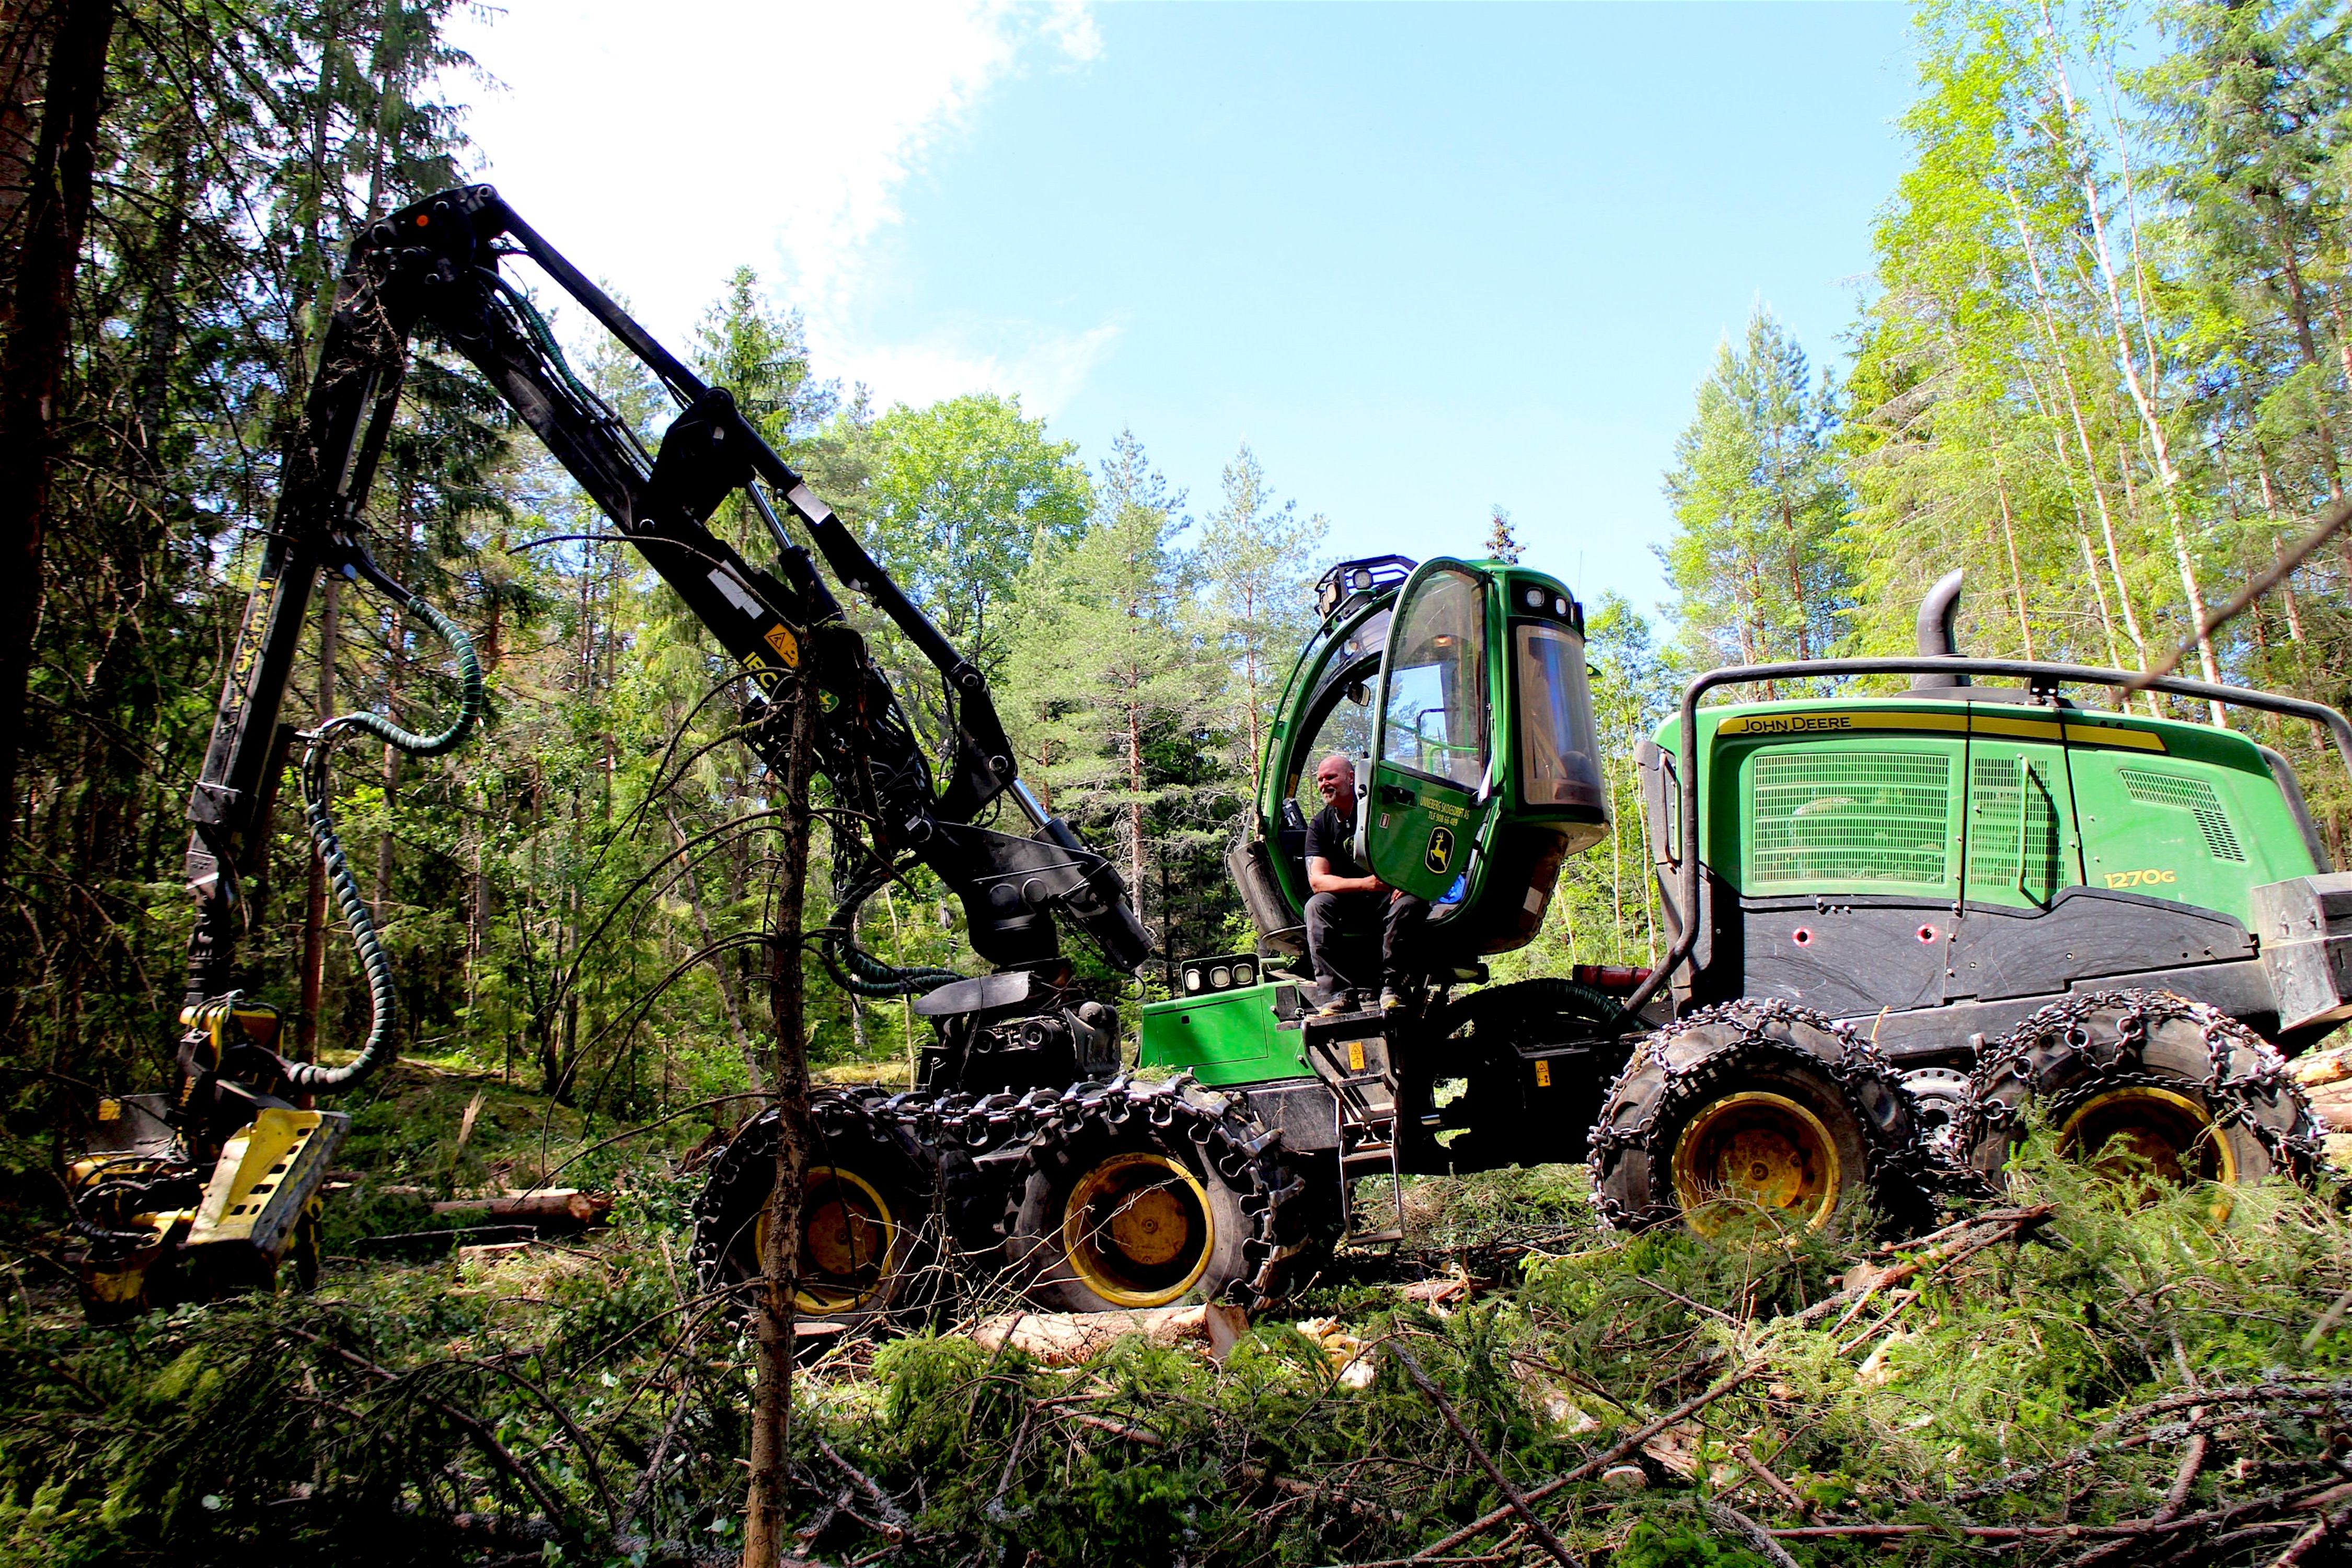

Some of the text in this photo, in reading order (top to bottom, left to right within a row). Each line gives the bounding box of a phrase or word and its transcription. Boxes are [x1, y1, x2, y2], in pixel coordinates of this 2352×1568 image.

[1741, 717, 1851, 732] JOHN DEERE
[2104, 868, 2177, 889] 1270G
